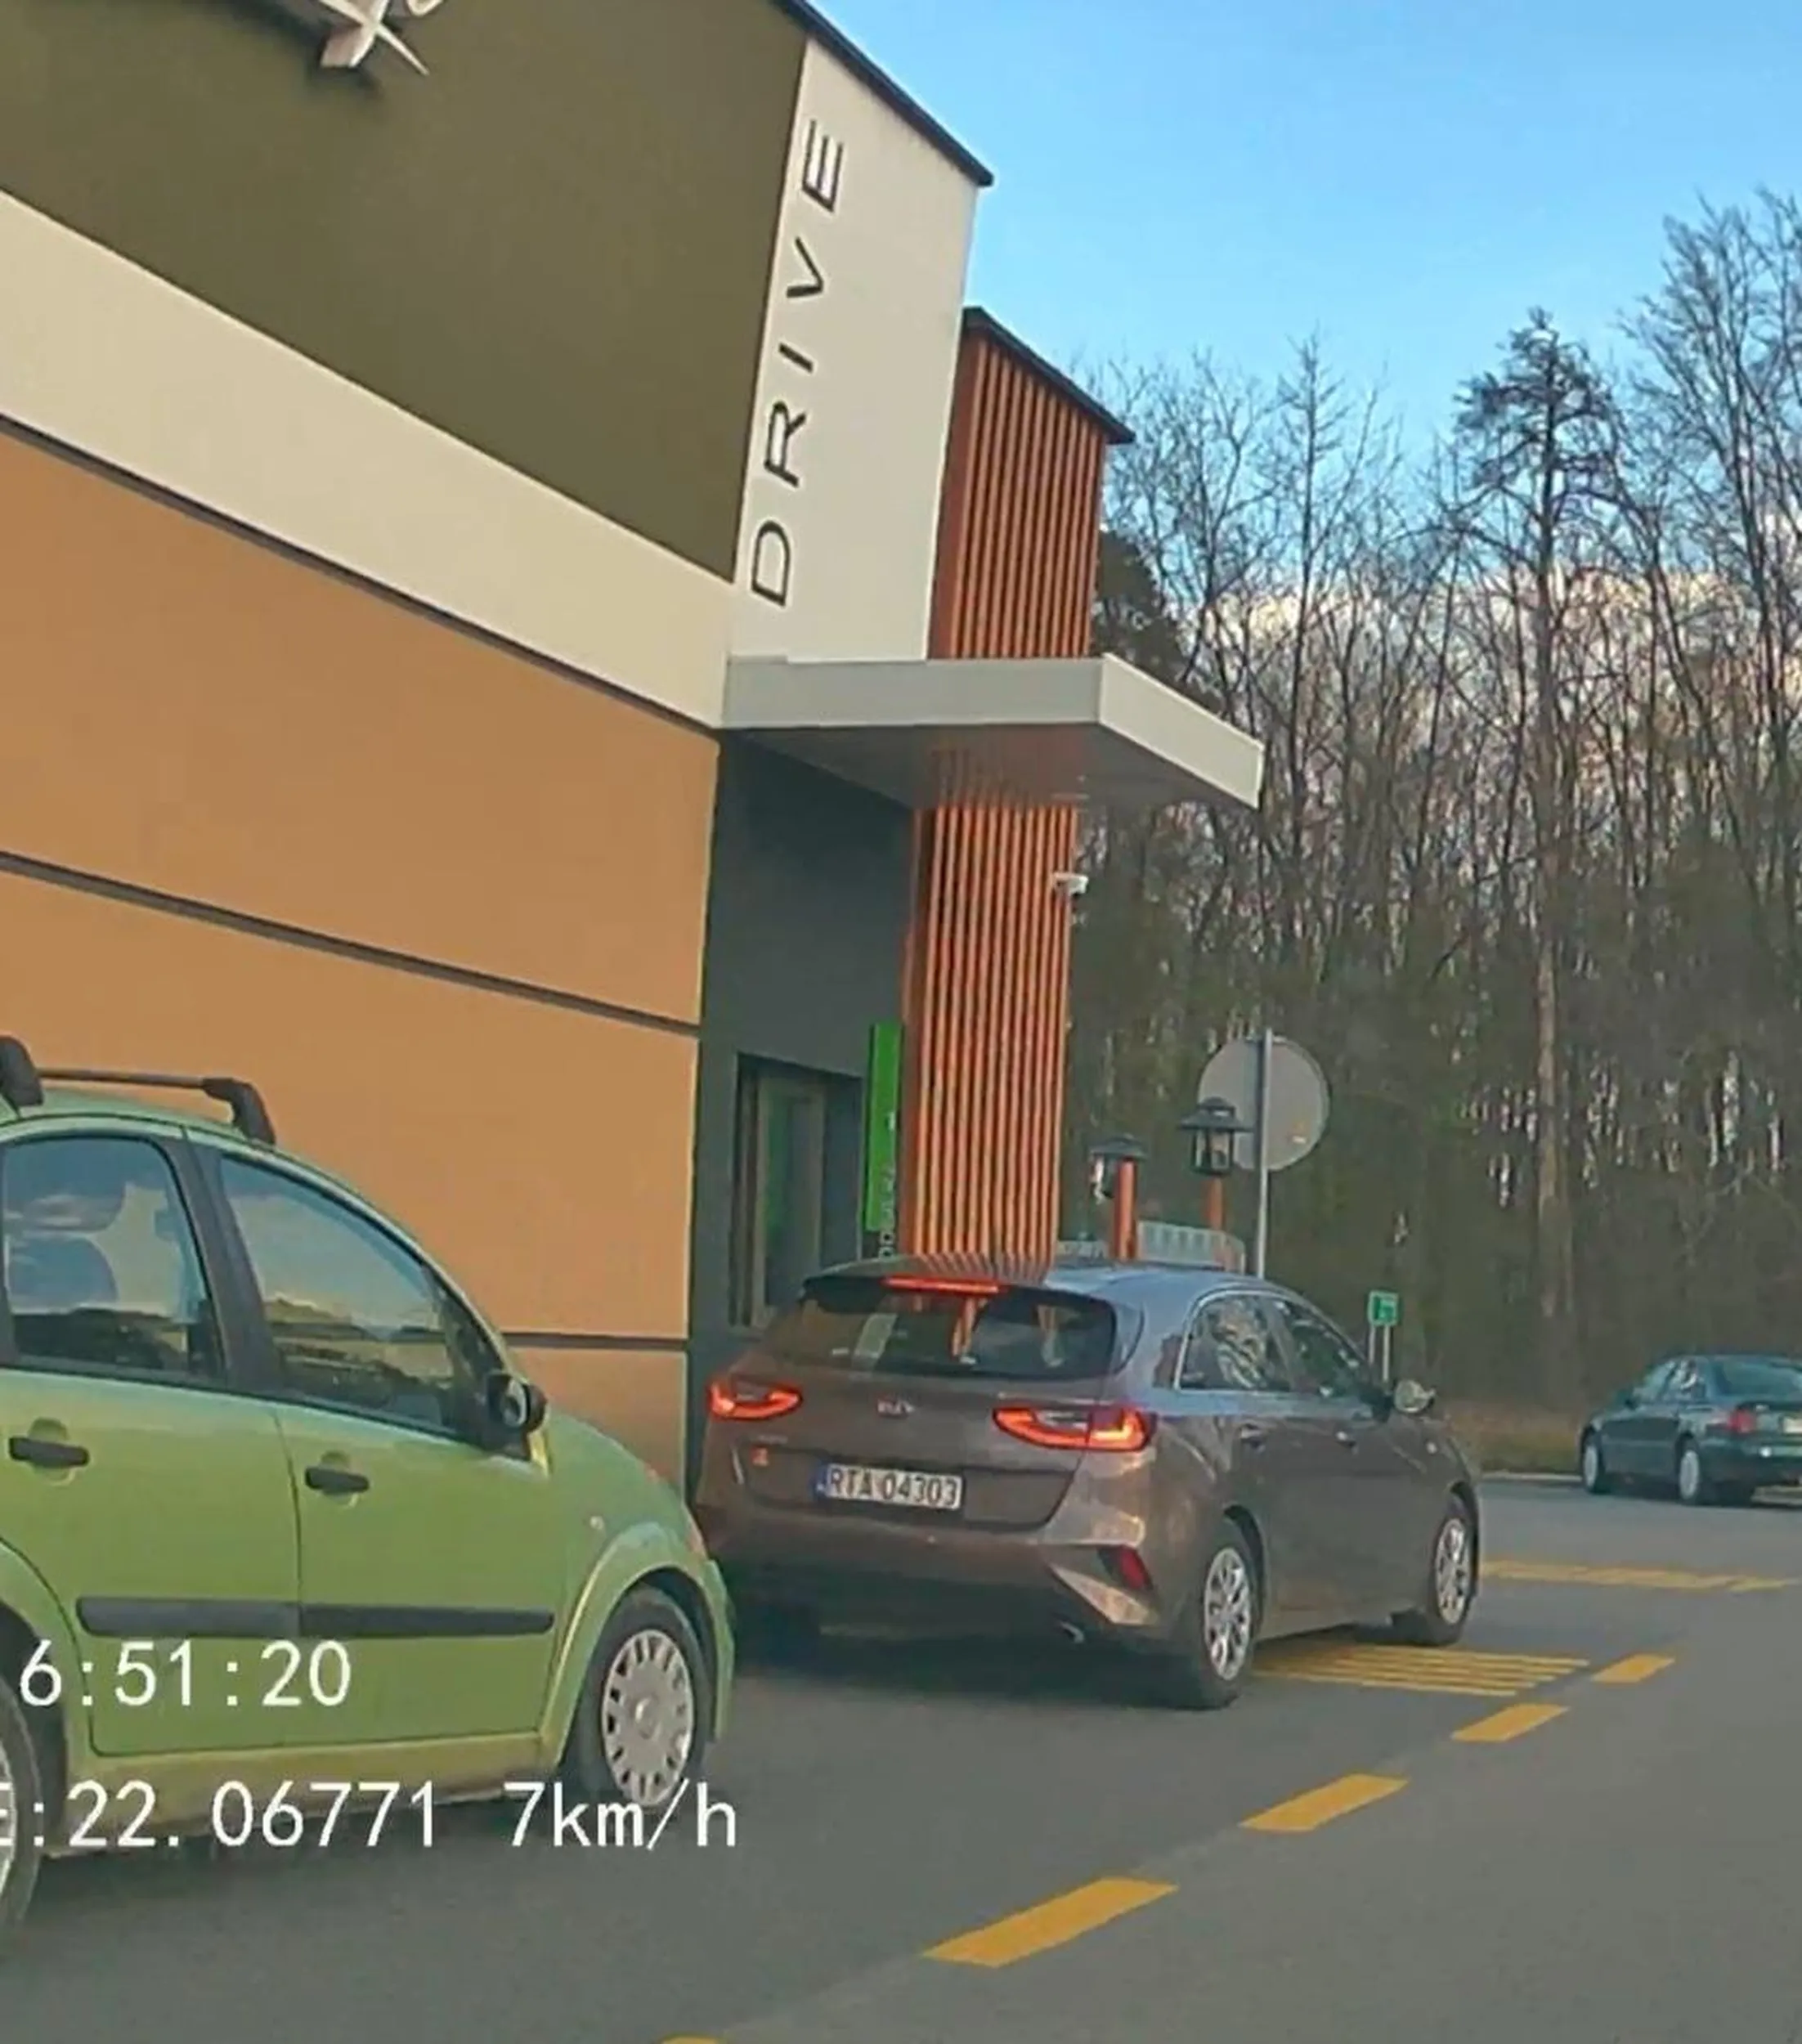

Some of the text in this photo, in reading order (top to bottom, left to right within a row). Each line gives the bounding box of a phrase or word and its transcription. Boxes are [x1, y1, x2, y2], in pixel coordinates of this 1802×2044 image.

[750, 119, 845, 607] DRIVE
[830, 1468, 958, 1507] RTA 04303
